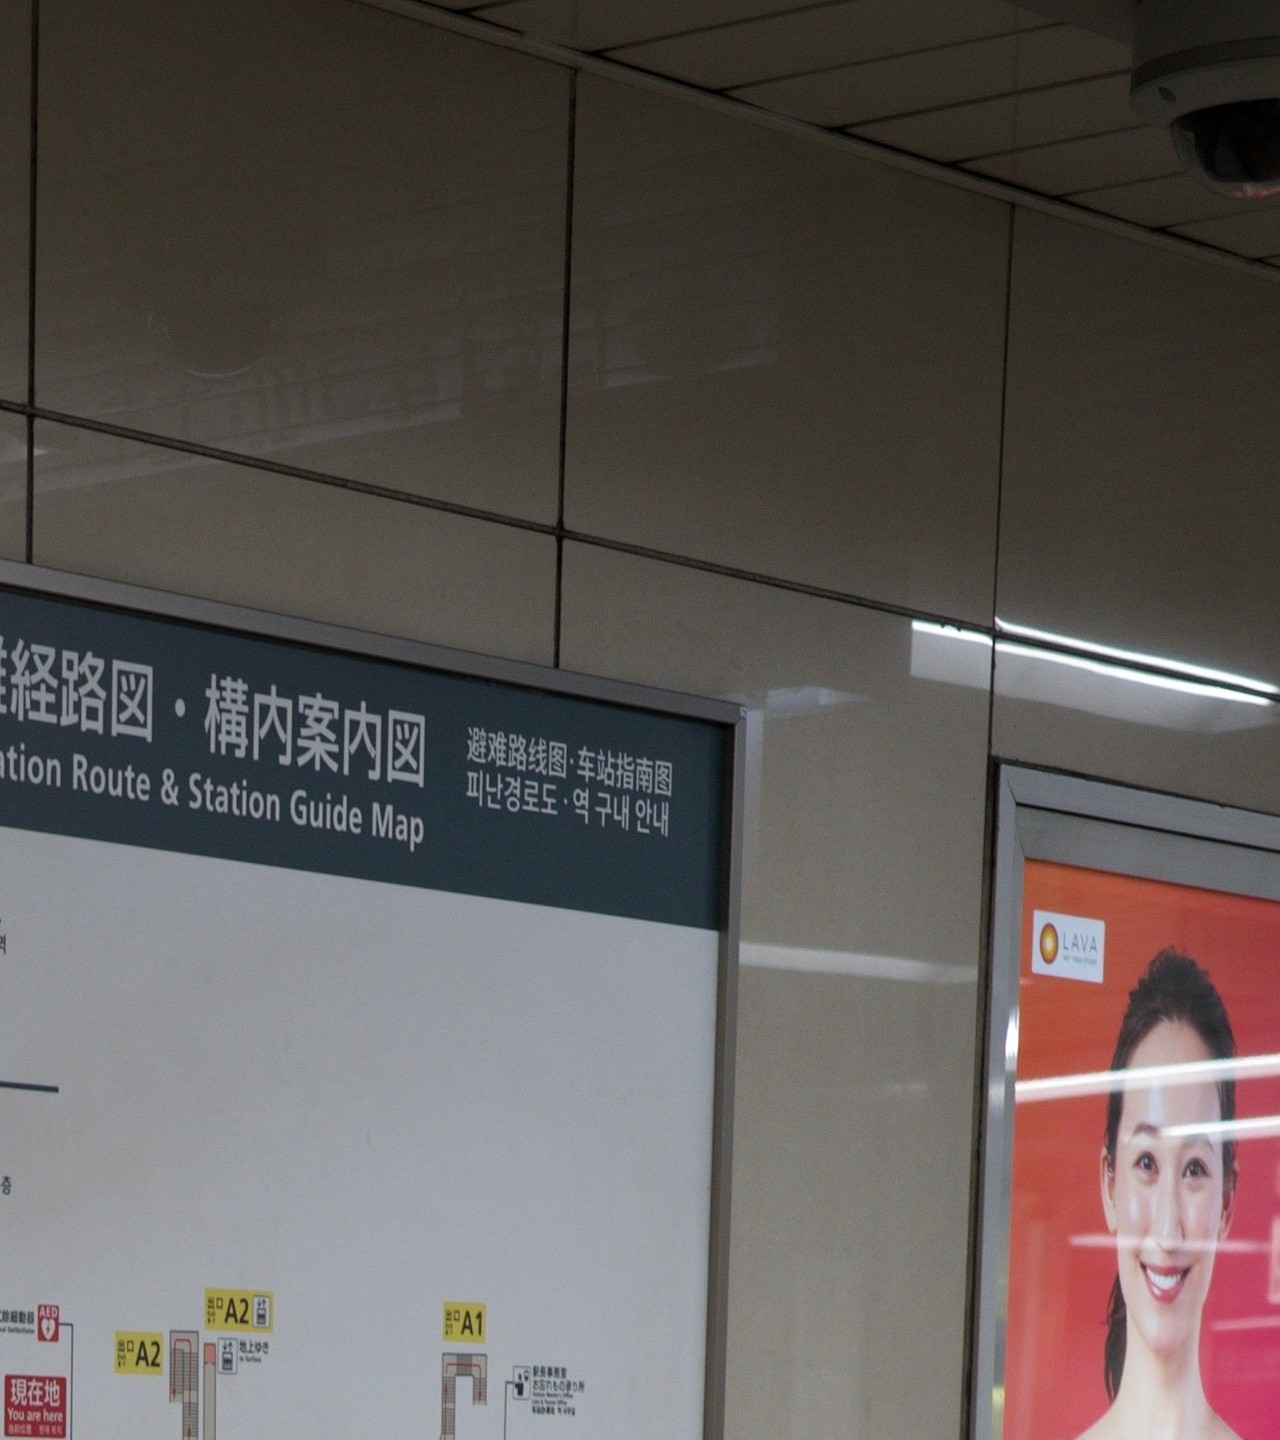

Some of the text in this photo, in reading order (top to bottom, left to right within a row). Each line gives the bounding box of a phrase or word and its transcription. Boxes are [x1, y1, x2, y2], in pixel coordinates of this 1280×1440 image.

[72, 753, 151, 801] Route
[161, 768, 179, 806] &
[189, 773, 281, 822] Station
[290, 789, 363, 836] Guide
[372, 802, 425, 852] Map
[595, 792, 630, 831] 구내
[635, 799, 670, 838] 안내
[1063, 930, 1098, 955] LAVA
[39, 1306, 58, 1318] AED
[225, 1297, 249, 1325] A2
[461, 1310, 482, 1337] A1
[135, 1340, 161, 1368] A2
[10, 1378, 60, 1407] 現在地
[7, 1407, 63, 1423] You are here
